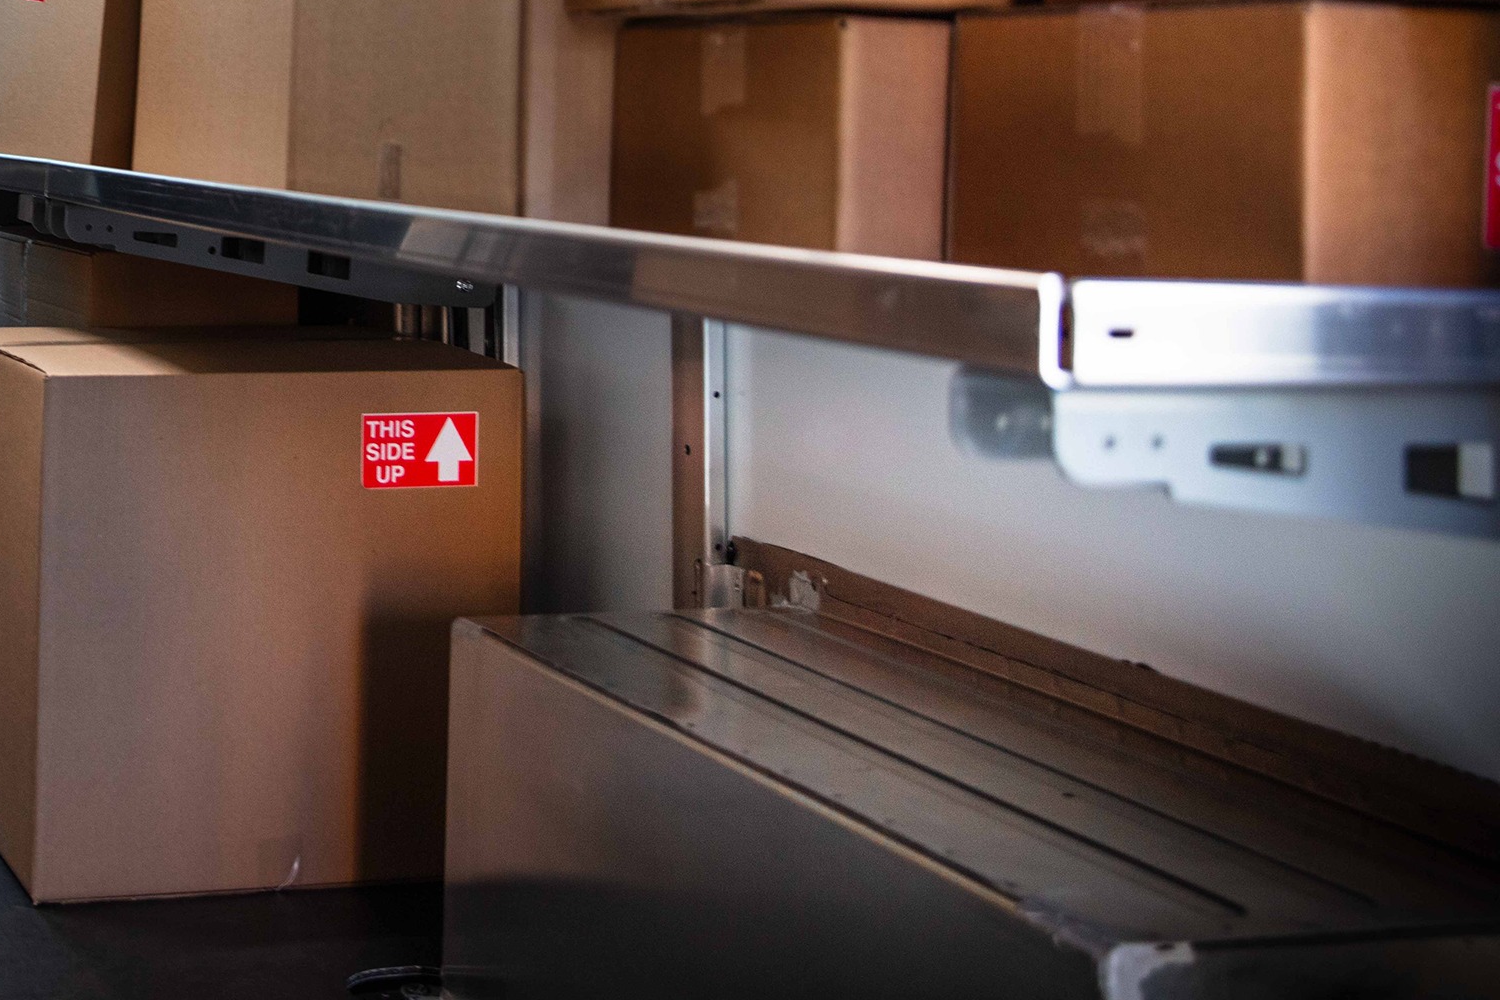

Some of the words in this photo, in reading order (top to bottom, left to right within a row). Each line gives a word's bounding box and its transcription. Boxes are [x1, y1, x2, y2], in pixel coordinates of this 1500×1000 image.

[366, 419, 415, 438] THIS
[366, 442, 416, 462] SIDE
[376, 465, 406, 484] UP
